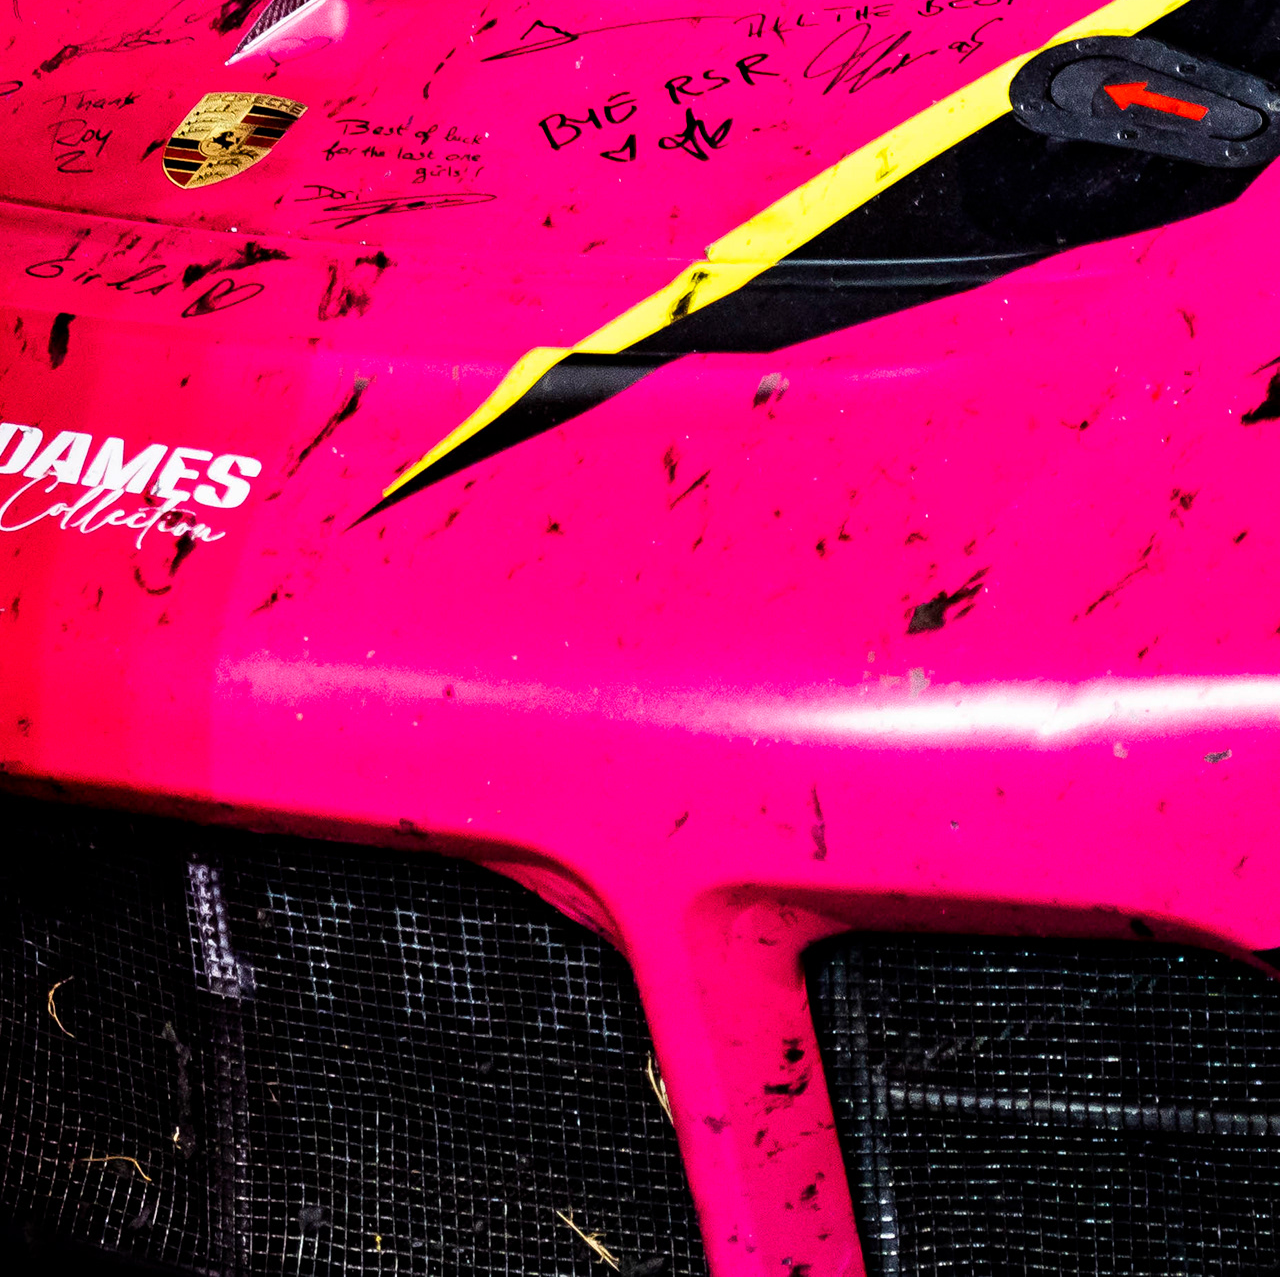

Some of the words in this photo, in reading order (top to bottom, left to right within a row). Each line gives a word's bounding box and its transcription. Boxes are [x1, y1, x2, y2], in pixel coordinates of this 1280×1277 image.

[539, 93, 637, 151] BYE
[665, 53, 781, 104] RSR
[414, 126, 439, 146] of
[323, 143, 358, 165] for
[360, 145, 386, 163] the
[397, 147, 434, 162] last
[445, 152, 482, 163] one
